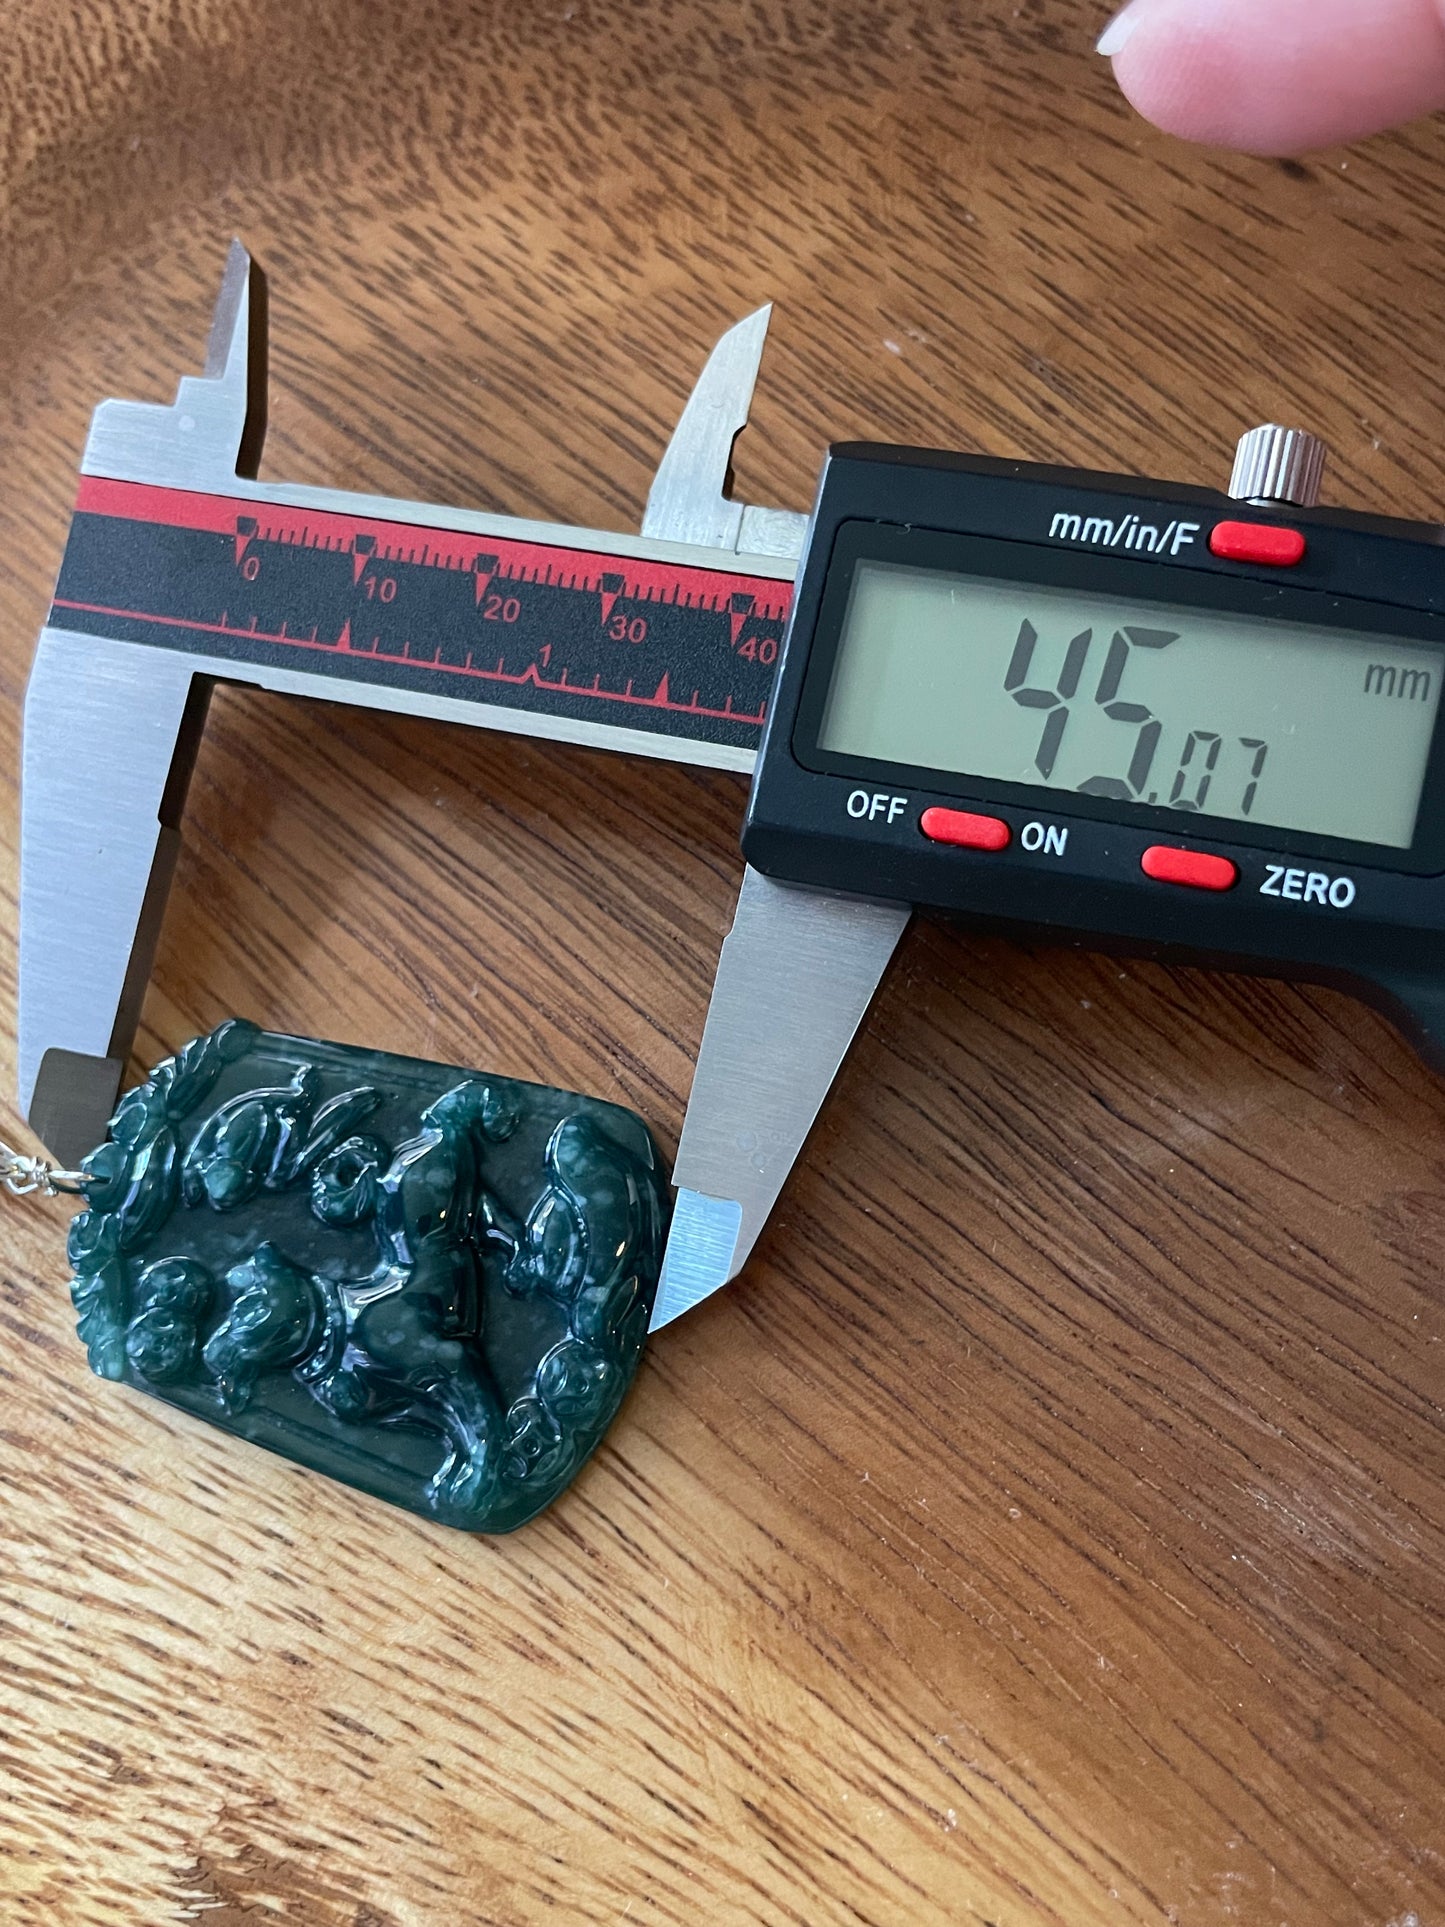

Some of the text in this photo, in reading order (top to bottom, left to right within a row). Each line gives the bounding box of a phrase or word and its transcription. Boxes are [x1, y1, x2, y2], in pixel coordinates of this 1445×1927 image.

[1049, 512, 1200, 556] mm/in/F
[242, 556, 778, 665] 0 10 20 30 40
[539, 643, 552, 668] 1
[1363, 662, 1431, 702] mm
[1003, 617, 1268, 815] 45.07
[846, 789, 908, 824] OFF
[1020, 822, 1068, 857] ON
[1259, 863, 1356, 909] ZERO
